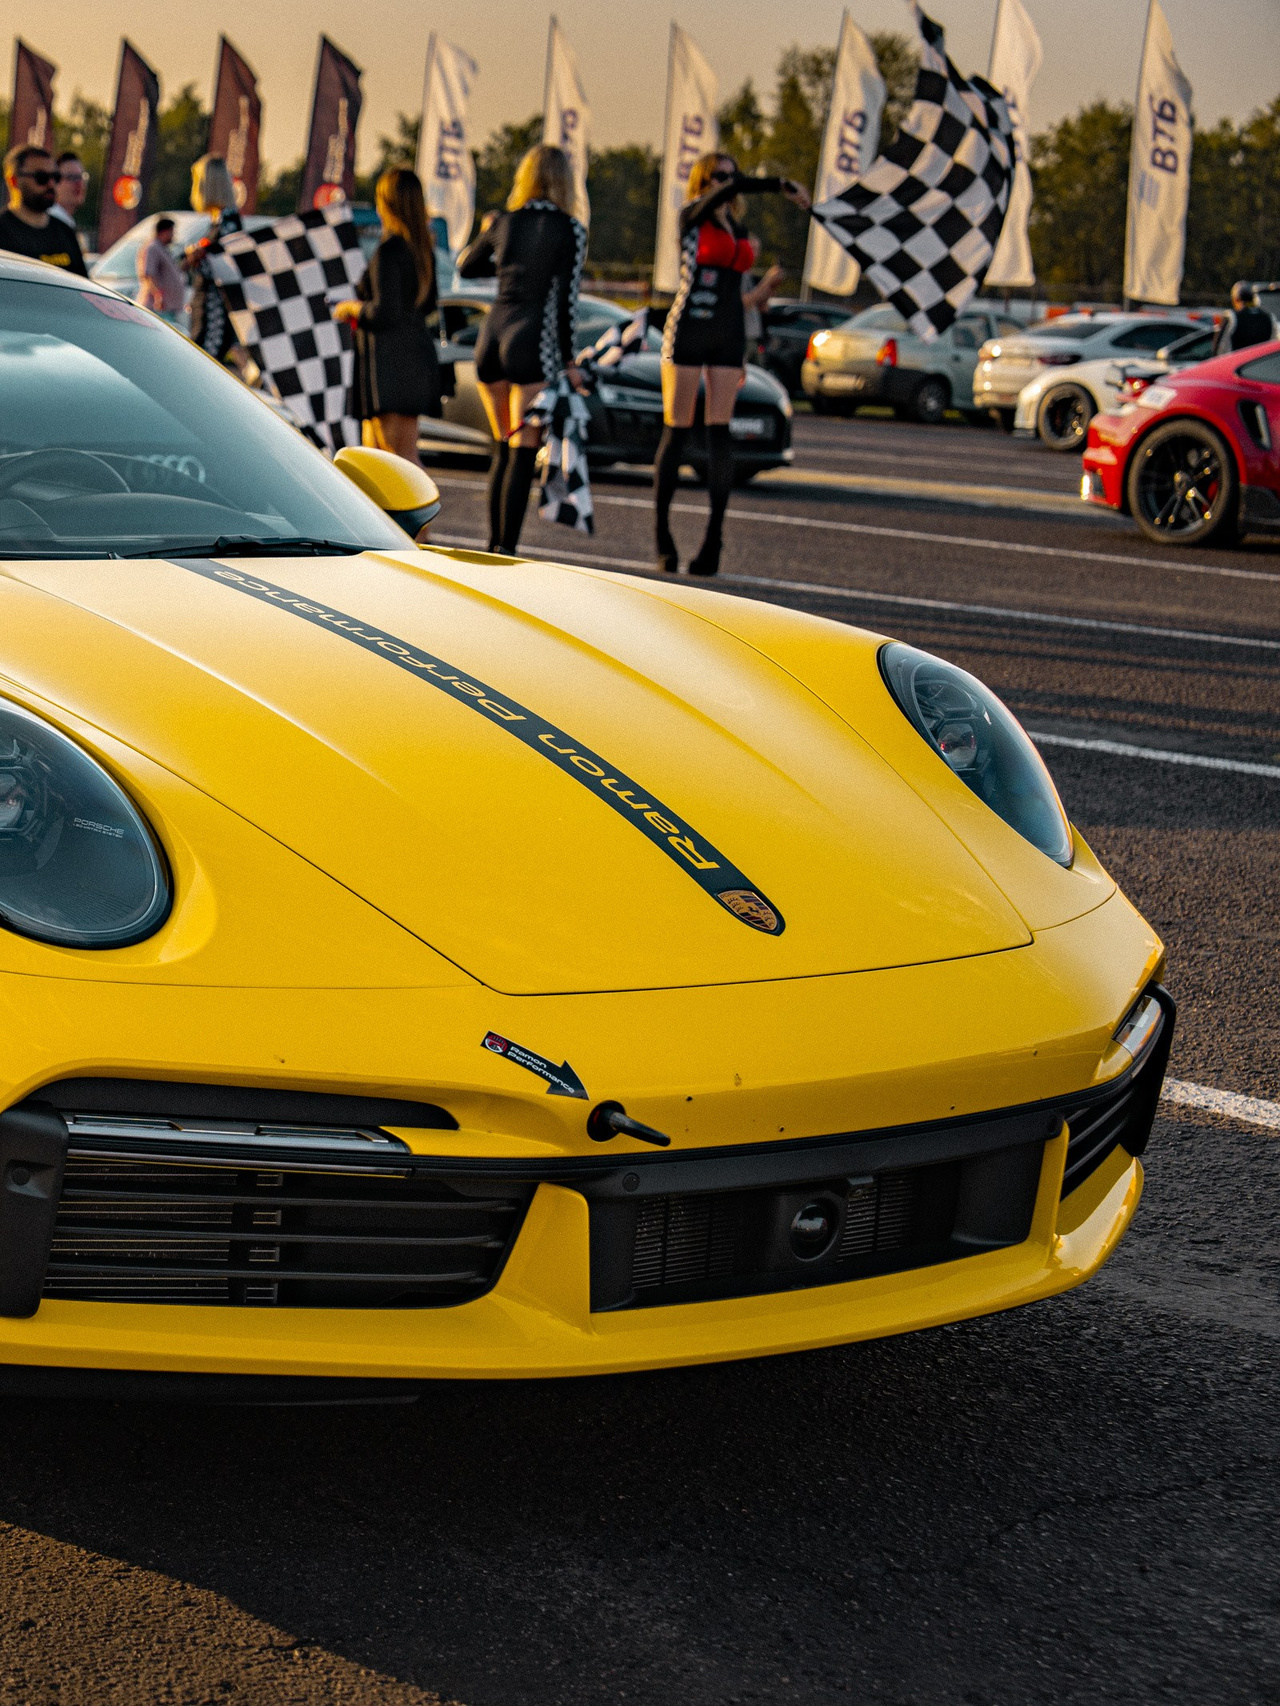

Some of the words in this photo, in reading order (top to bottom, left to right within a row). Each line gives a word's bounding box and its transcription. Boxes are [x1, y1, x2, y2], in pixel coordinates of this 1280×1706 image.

[1149, 93, 1178, 173] ВТБ
[213, 570, 528, 722] Performance
[73, 817, 125, 836] PORSCHE
[537, 733, 721, 870] Ramon
[507, 1051, 575, 1094] Performance
[510, 1046, 547, 1068] Ramon
